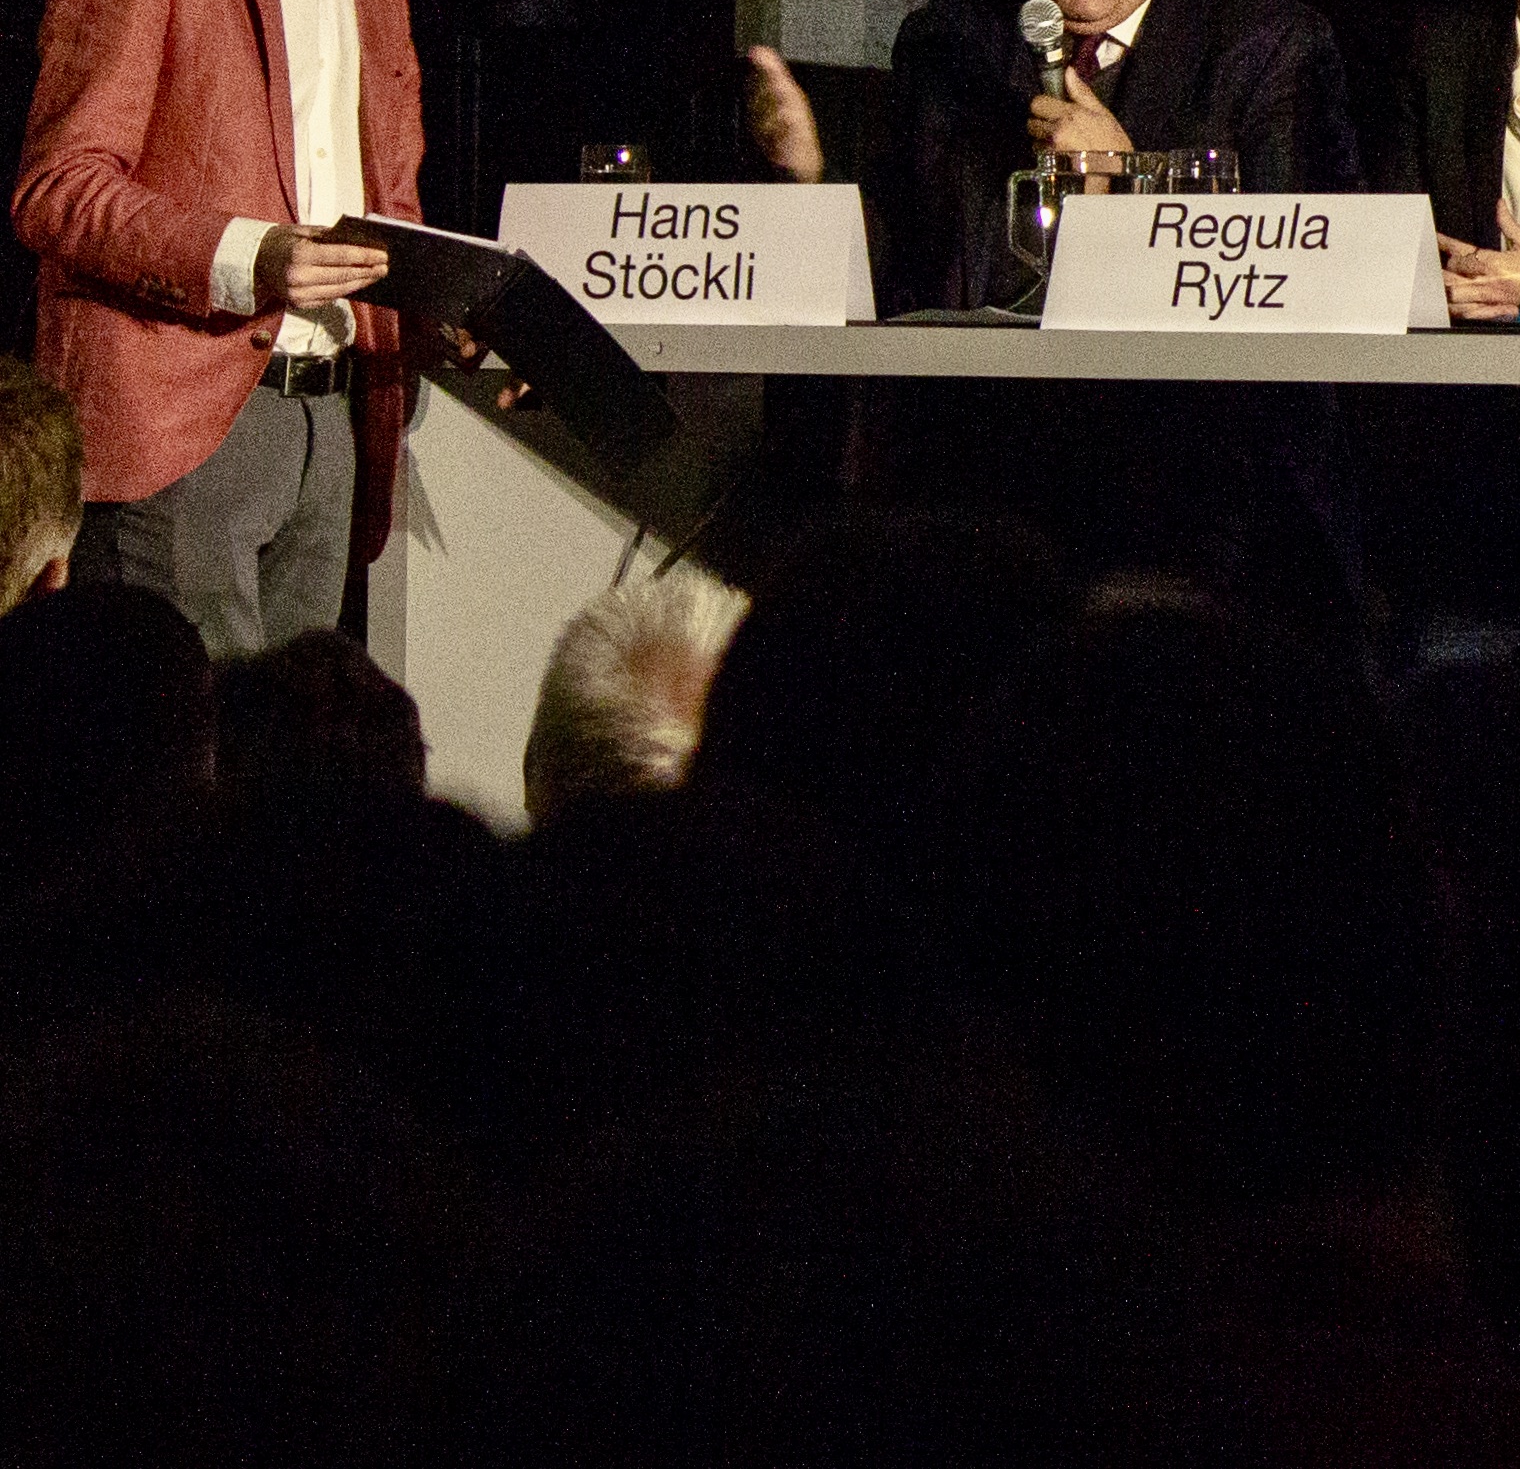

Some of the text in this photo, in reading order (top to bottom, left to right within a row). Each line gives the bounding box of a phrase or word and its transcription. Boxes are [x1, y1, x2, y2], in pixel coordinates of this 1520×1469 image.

[611, 193, 740, 240] Hans
[1149, 202, 1330, 261] Regula
[582, 250, 756, 301] Stöckli
[1172, 261, 1289, 321] Rytz
